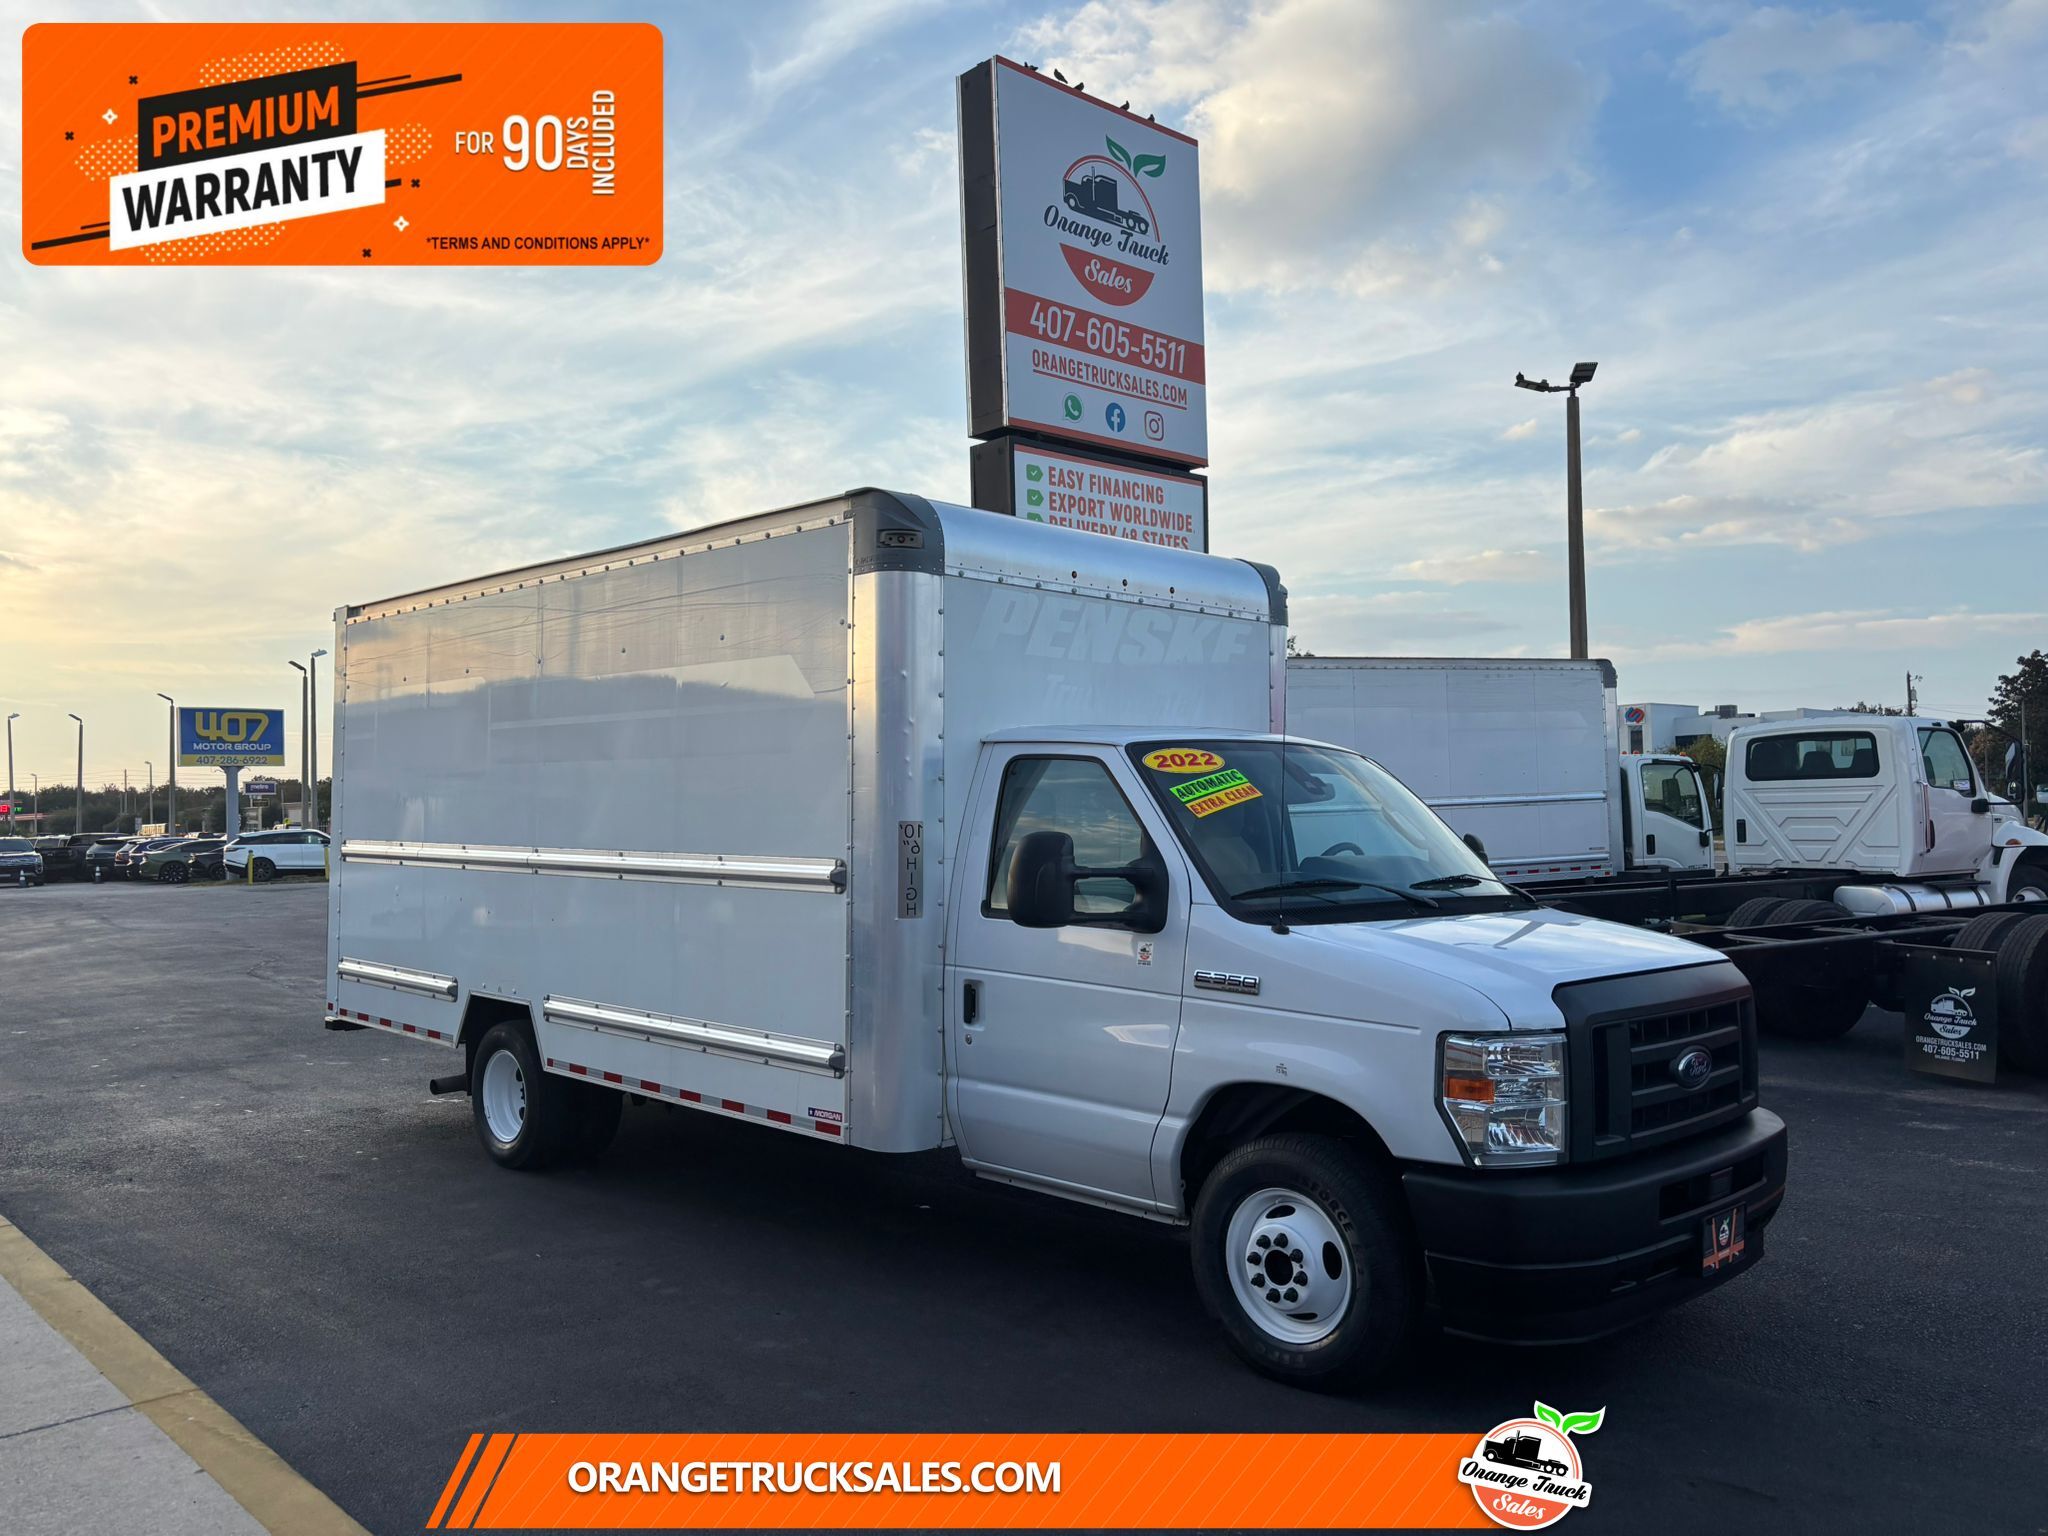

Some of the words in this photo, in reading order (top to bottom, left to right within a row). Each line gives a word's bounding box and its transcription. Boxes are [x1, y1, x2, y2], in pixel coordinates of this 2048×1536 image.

[1044, 204, 1113, 247] Orange
[1117, 229, 1170, 266] Truck
[1084, 258, 1133, 294] Sales
[1029, 301, 1186, 374] 407-605-5511
[1032, 348, 1187, 405] ORANGETRUCKSALES.COM
[1048, 465, 1085, 489] EASY
[1089, 473, 1165, 505] FINANCING
[1049, 491, 1105, 519] EXPORT
[1109, 501, 1193, 534] WORLDWIDE
[1142, 530, 1189, 550] STATES
[971, 588, 1252, 664] PENSKE
[195, 711, 269, 742] 407
[193, 742, 232, 751] MOTOR
[234, 743, 272, 751] GROUP
[196, 755, 268, 765] 407-286-6922
[1153, 752, 1218, 769] 2022
[1176, 769, 1244, 799] AUTOMATIC
[1189, 798, 1225, 816] EXTRA
[1225, 784, 1258, 802] CLEAN
[1922, 1044, 1979, 1060] 407-605-5511
[813, 1109, 841, 1121] MORGAN
